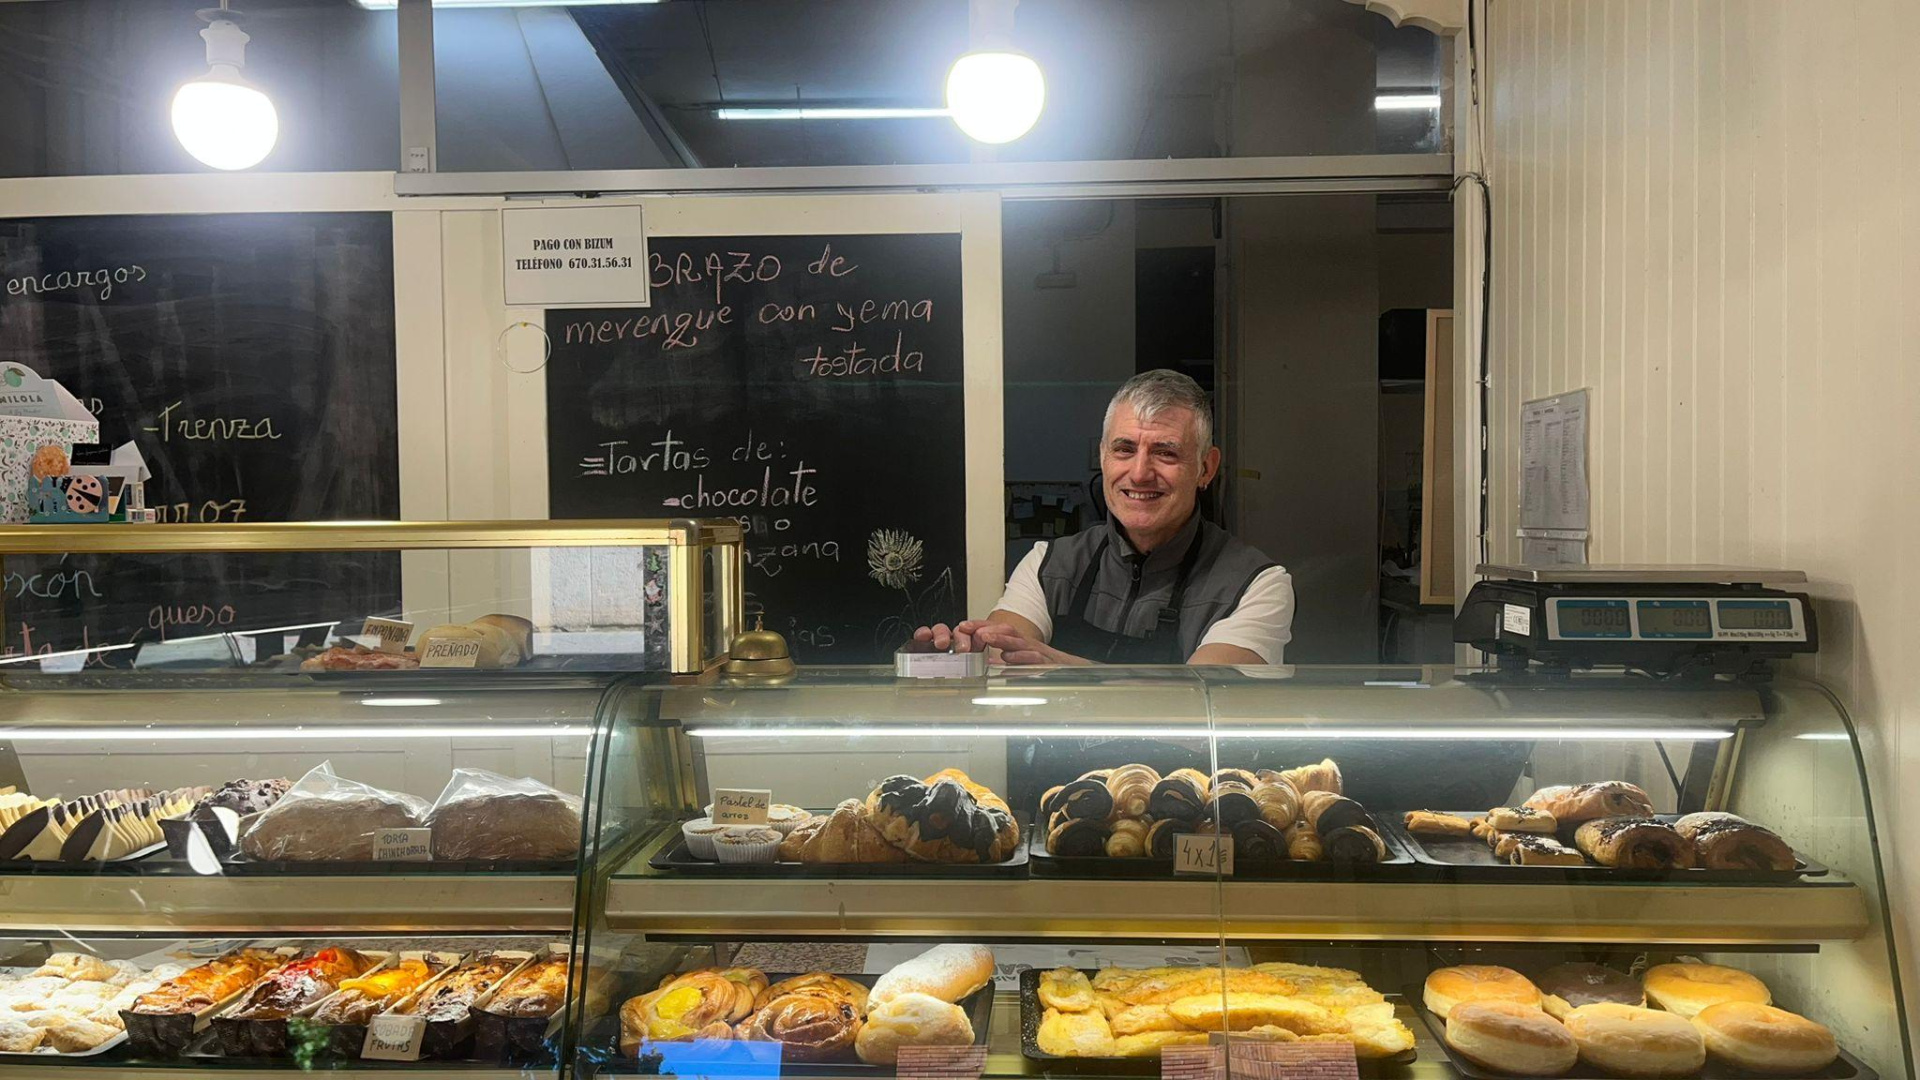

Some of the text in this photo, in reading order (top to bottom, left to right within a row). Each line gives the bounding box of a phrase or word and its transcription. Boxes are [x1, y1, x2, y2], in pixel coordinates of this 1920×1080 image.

[533, 238, 613, 250] PAGO CON BIZUM
[516, 257, 632, 270] TELÉFONO 670.31.56.31
[648, 242, 858, 304] BRAZO de
[7, 265, 146, 300] encargos
[565, 299, 933, 350] merengue con yema
[800, 330, 925, 376] tostada
[4, 552, 102, 598] scón
[149, 605, 236, 643] queso
[425, 642, 479, 658] PREÑADO
[720, 796, 766, 809] Pastel de
[382, 831, 409, 844] TORTA
[372, 1023, 414, 1037] SOBADA
